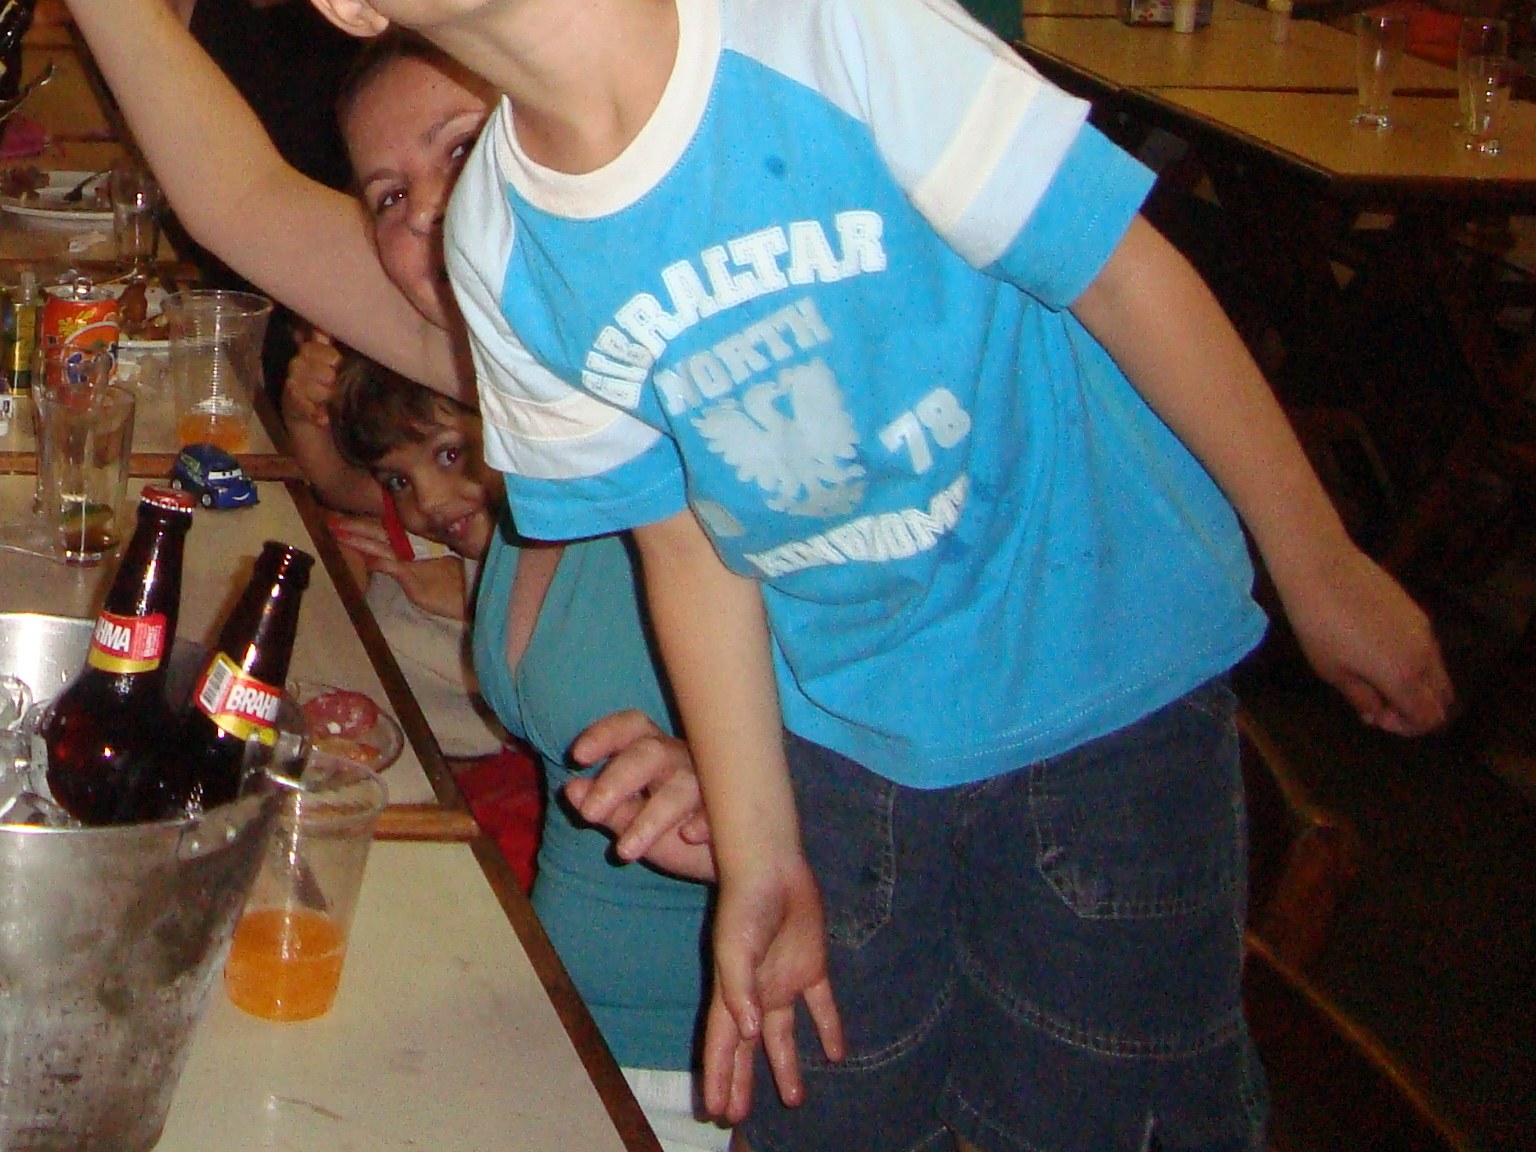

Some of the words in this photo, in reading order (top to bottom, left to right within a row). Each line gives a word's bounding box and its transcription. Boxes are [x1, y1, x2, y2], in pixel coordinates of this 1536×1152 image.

[653, 297, 834, 416] NORTH
[878, 387, 972, 475] 78
[225, 684, 282, 722] BRAH
